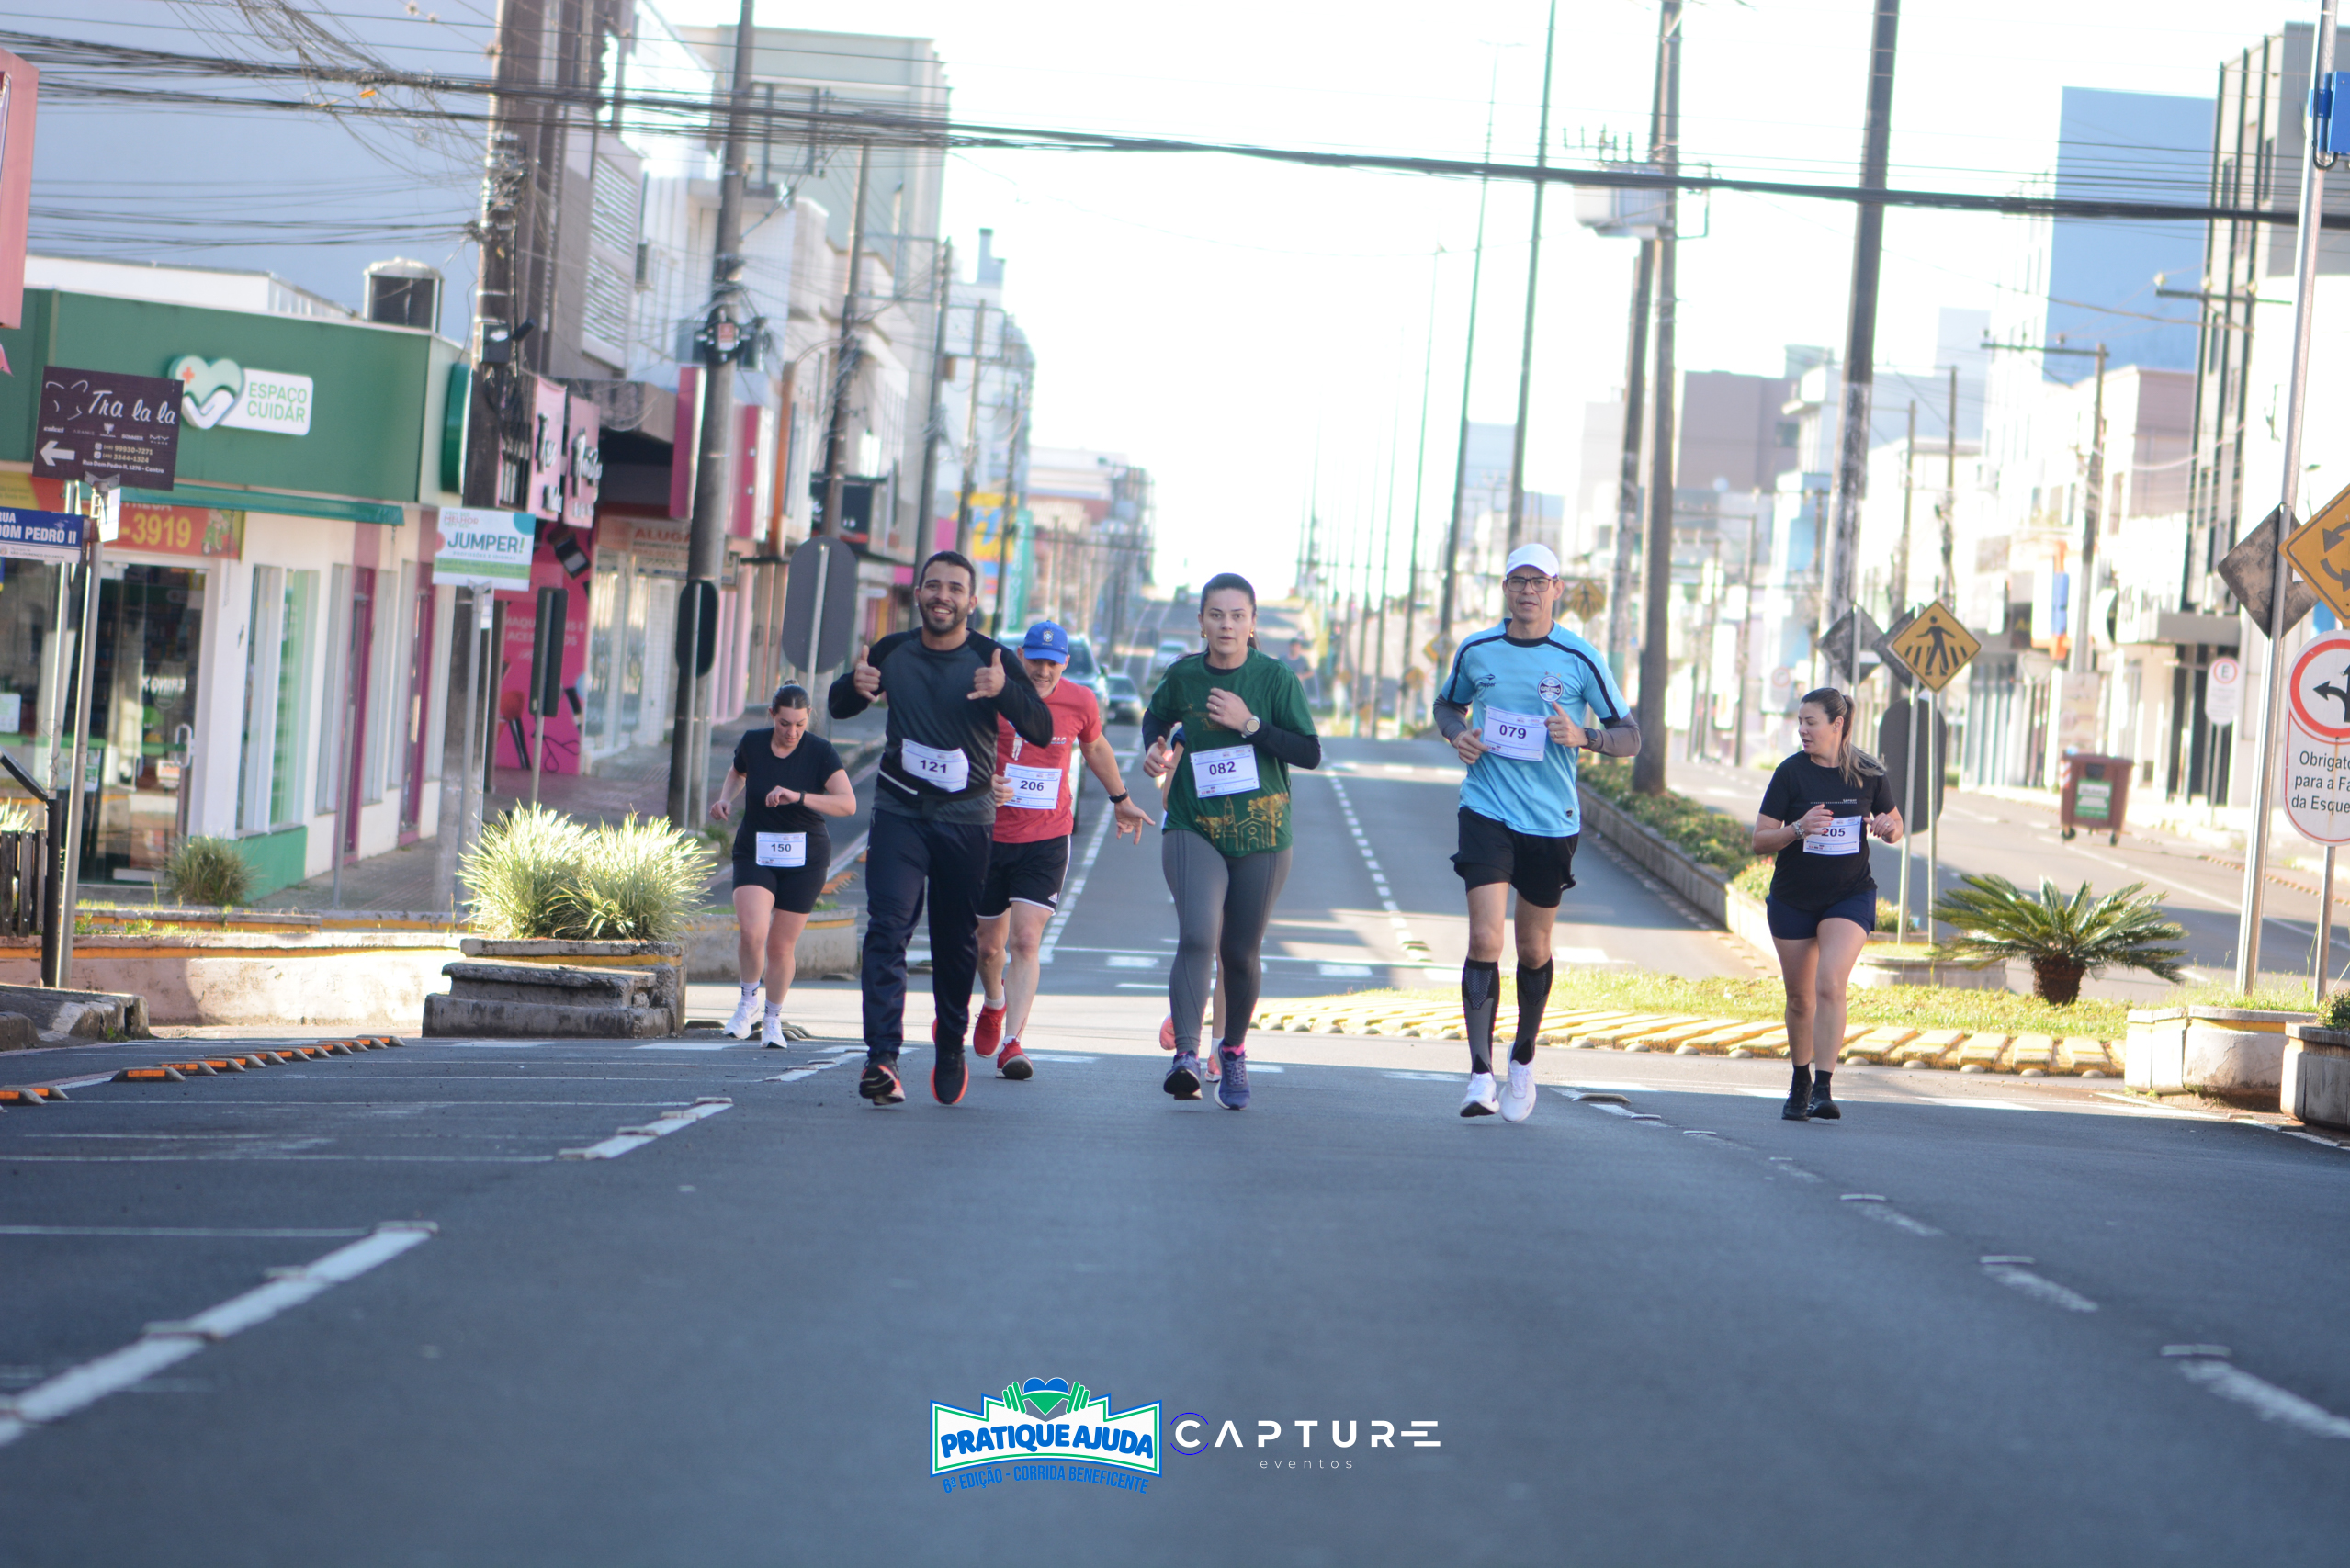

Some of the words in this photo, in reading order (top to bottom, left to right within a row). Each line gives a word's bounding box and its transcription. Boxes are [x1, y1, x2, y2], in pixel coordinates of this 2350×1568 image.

[249, 381, 308, 406] ESPAÇO
[88, 390, 124, 418] Tra
[131, 399, 152, 423] la
[156, 400, 176, 424] la
[247, 400, 306, 423] CUIDAR
[445, 515, 479, 525] MELHOR
[24, 525, 65, 544] PEDRO
[68, 530, 77, 545] II
[119, 513, 192, 548] -3919
[447, 532, 525, 554] JUMPER!
[1499, 724, 1527, 739] 079
[920, 759, 947, 774] 121
[1209, 761, 1237, 775] 082
[1020, 780, 1045, 792] 206
[2295, 775, 2322, 790] para
[2327, 778, 2334, 790] a
[2291, 793, 2307, 809] da
[2310, 795, 2350, 816] Esque
[1821, 827, 1846, 838] 205
[771, 843, 792, 852] 150
